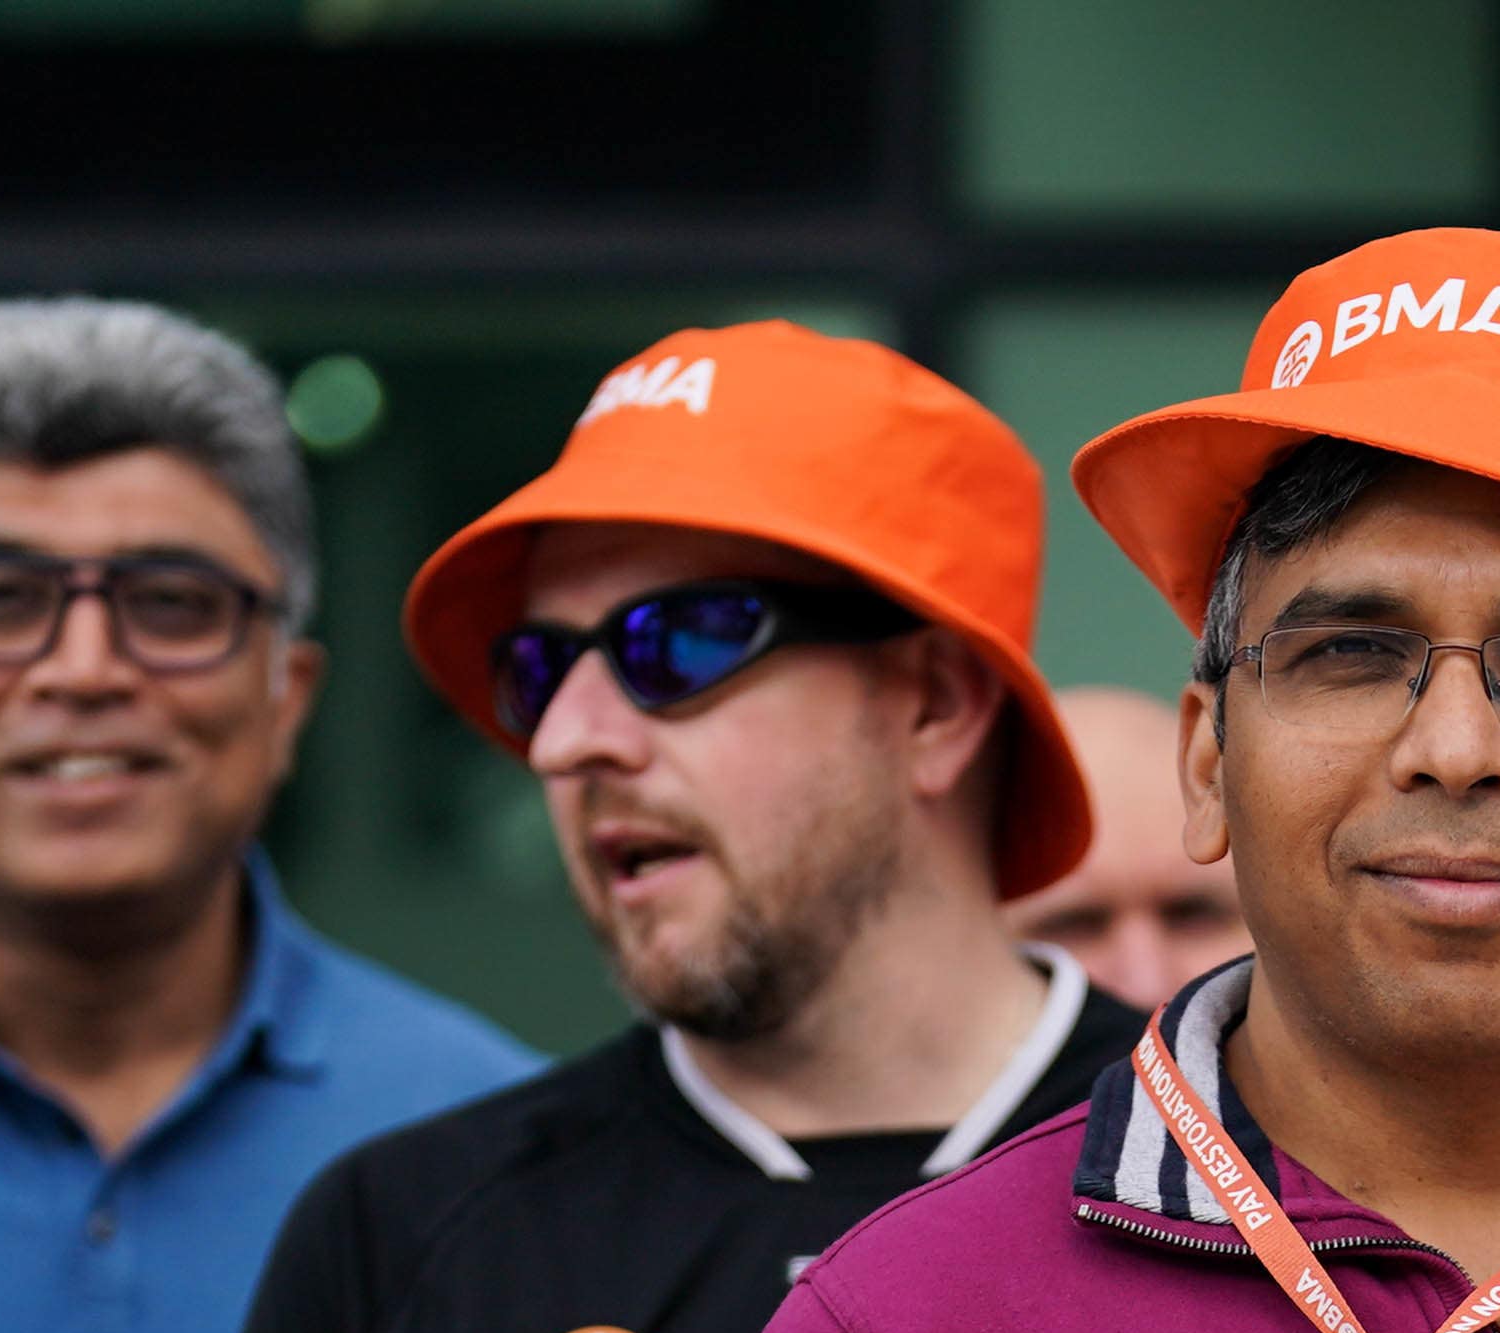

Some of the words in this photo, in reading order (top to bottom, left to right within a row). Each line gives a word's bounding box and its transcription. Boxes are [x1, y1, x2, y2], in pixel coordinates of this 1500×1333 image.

[1147, 1059, 1243, 1190] RESTORATION
[1228, 1186, 1273, 1231] PAY
[1293, 1267, 1345, 1331] BMA
